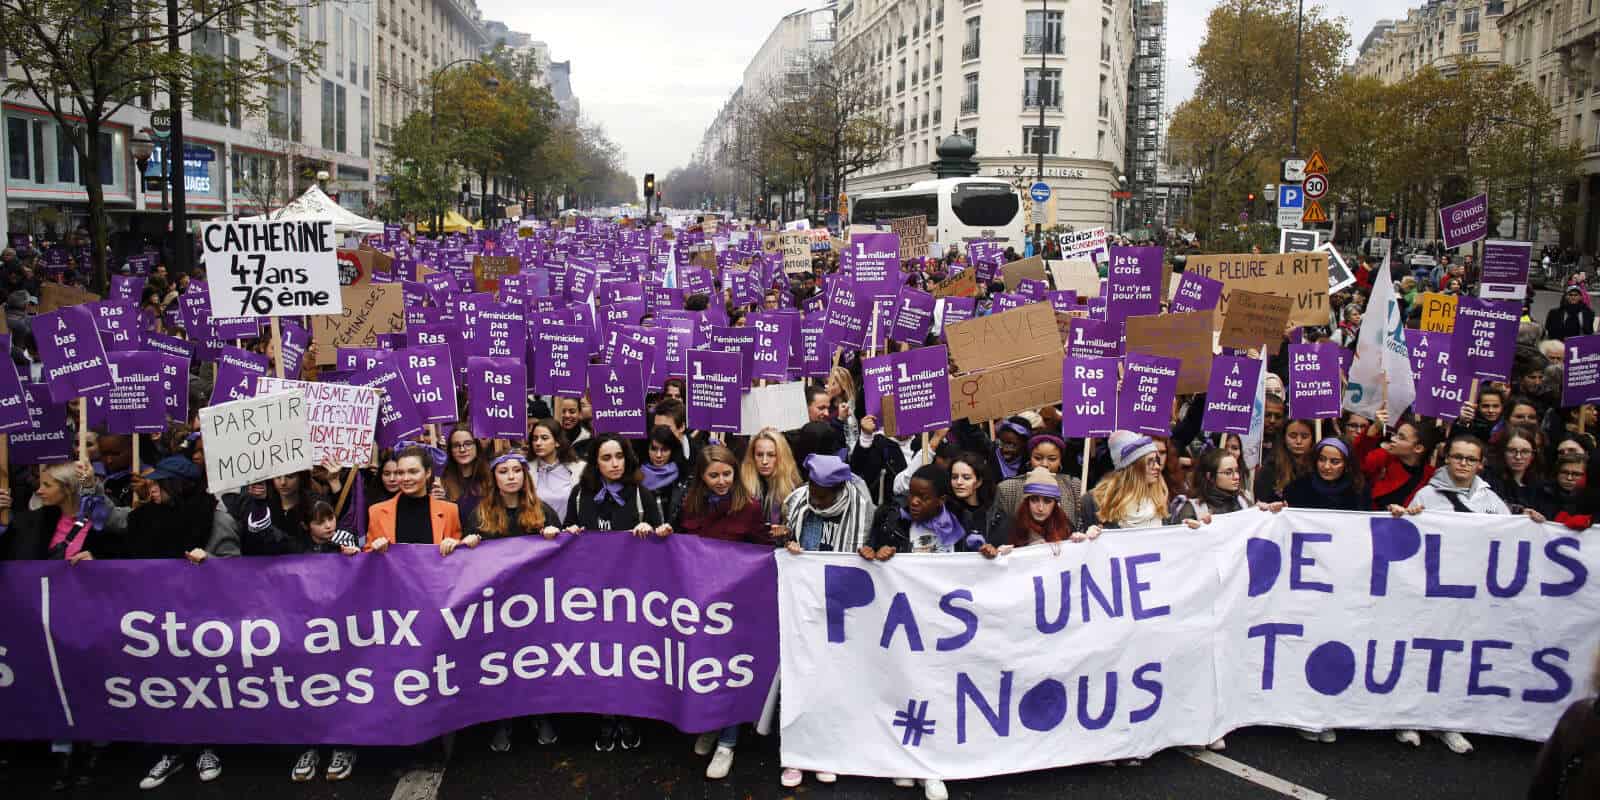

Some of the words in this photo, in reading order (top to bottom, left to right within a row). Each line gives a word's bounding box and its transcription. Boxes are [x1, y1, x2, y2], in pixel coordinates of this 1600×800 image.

[1307, 181, 1323, 192] 30
[1285, 189, 1297, 205] P
[856, 243, 866, 259] 1
[867, 250, 896, 259] milliard
[1114, 255, 1125, 266] Je
[1127, 256, 1138, 265] te
[1114, 265, 1142, 275] crois
[1219, 260, 1266, 280] PLEURE
[1113, 284, 1124, 292] Tu
[1125, 284, 1140, 294] n'y
[1180, 288, 1202, 300] crois
[186, 296, 205, 308] Ras
[614, 290, 622, 302] 1
[834, 296, 856, 308] crois
[999, 297, 1017, 308] Ras
[1112, 293, 1134, 302] pour
[1135, 292, 1152, 300] rien
[100, 305, 124, 317] Ras
[946, 302, 953, 314] 1
[1459, 306, 1518, 322] Féminicides
[478, 311, 524, 321] Féminicides
[608, 310, 629, 321] Ras
[57, 316, 67, 331] À
[106, 317, 120, 329] le
[490, 322, 508, 330] pas
[755, 319, 779, 333] Ras
[1474, 319, 1496, 331] pas
[54, 332, 76, 347] bas
[418, 332, 446, 345] Ras
[490, 330, 509, 338] une
[539, 332, 585, 344] Féminicides
[713, 334, 754, 345] Féminicides
[1074, 327, 1086, 346] 1
[1085, 339, 1117, 350] milliard
[1471, 328, 1496, 339] une
[147, 337, 191, 356] Féminicides
[494, 338, 506, 347] de
[759, 334, 772, 347] le
[1475, 337, 1491, 348] de
[63, 347, 76, 359] le
[488, 346, 511, 356] plus
[551, 343, 569, 352] pas
[620, 342, 644, 362] Ras
[1466, 347, 1496, 360] plus
[408, 355, 437, 369] Ras
[551, 351, 569, 360] une
[753, 349, 777, 363] viol
[1294, 353, 1304, 364] Je
[1306, 353, 1318, 362] te
[1569, 347, 1581, 364] 1
[49, 355, 103, 381] patriarcat
[223, 354, 266, 374] Féminicides
[554, 360, 567, 368] de
[1127, 362, 1176, 377] Féminicides
[1231, 362, 1240, 376] À
[1295, 361, 1321, 372] crois
[123, 373, 160, 383] milliard
[416, 371, 432, 386] le
[484, 371, 512, 386] Ras
[549, 367, 571, 378] plus
[609, 367, 618, 382] À
[693, 360, 705, 381] 1
[704, 373, 738, 384] milliard
[897, 362, 911, 383] 1
[911, 367, 945, 382] milliard
[1074, 366, 1104, 380] Ras
[1441, 371, 1457, 385] le
[1139, 375, 1159, 386] pas
[1224, 375, 1243, 388] bas
[1295, 381, 1306, 389] Tu
[491, 387, 505, 401] le
[604, 382, 625, 395] bas
[692, 389, 723, 398] violences
[898, 382, 920, 393] contre
[899, 388, 933, 399] violences
[1081, 383, 1097, 398] le
[1137, 383, 1158, 394] une
[1228, 388, 1238, 400] le
[1295, 389, 1316, 400] pour
[1317, 388, 1333, 397] rien
[1431, 385, 1464, 403] viol
[413, 386, 443, 405] viol
[612, 395, 623, 406] le
[899, 394, 928, 406] sexistes
[1140, 392, 1154, 403] de
[110, 403, 147, 411] sexuelles
[381, 402, 394, 415] de
[485, 404, 514, 420] viol
[692, 401, 723, 410] sexuelles
[900, 401, 934, 412] sexuelles
[1075, 400, 1105, 416] viol
[1133, 401, 1157, 414] plus
[1207, 400, 1251, 414] patriarcat
[212, 397, 302, 437] PARTIR
[380, 409, 403, 428] plus
[595, 407, 642, 420] patriarcat
[10, 429, 65, 445] patriarcat
[247, 428, 274, 446] OU
[217, 437, 305, 481] MOURIR
[824, 564, 979, 652] PAS
[1032, 552, 1171, 635] UNE
[1246, 532, 1334, 598] DE
[1368, 516, 1589, 600] PLUS
[120, 609, 281, 669] Stop
[303, 608, 422, 655] aux
[440, 577, 735, 640] violences
[1247, 622, 1574, 704] TOUTES
[104, 663, 375, 710] sexistes
[393, 653, 460, 706] et
[479, 637, 755, 695] sexuelles
